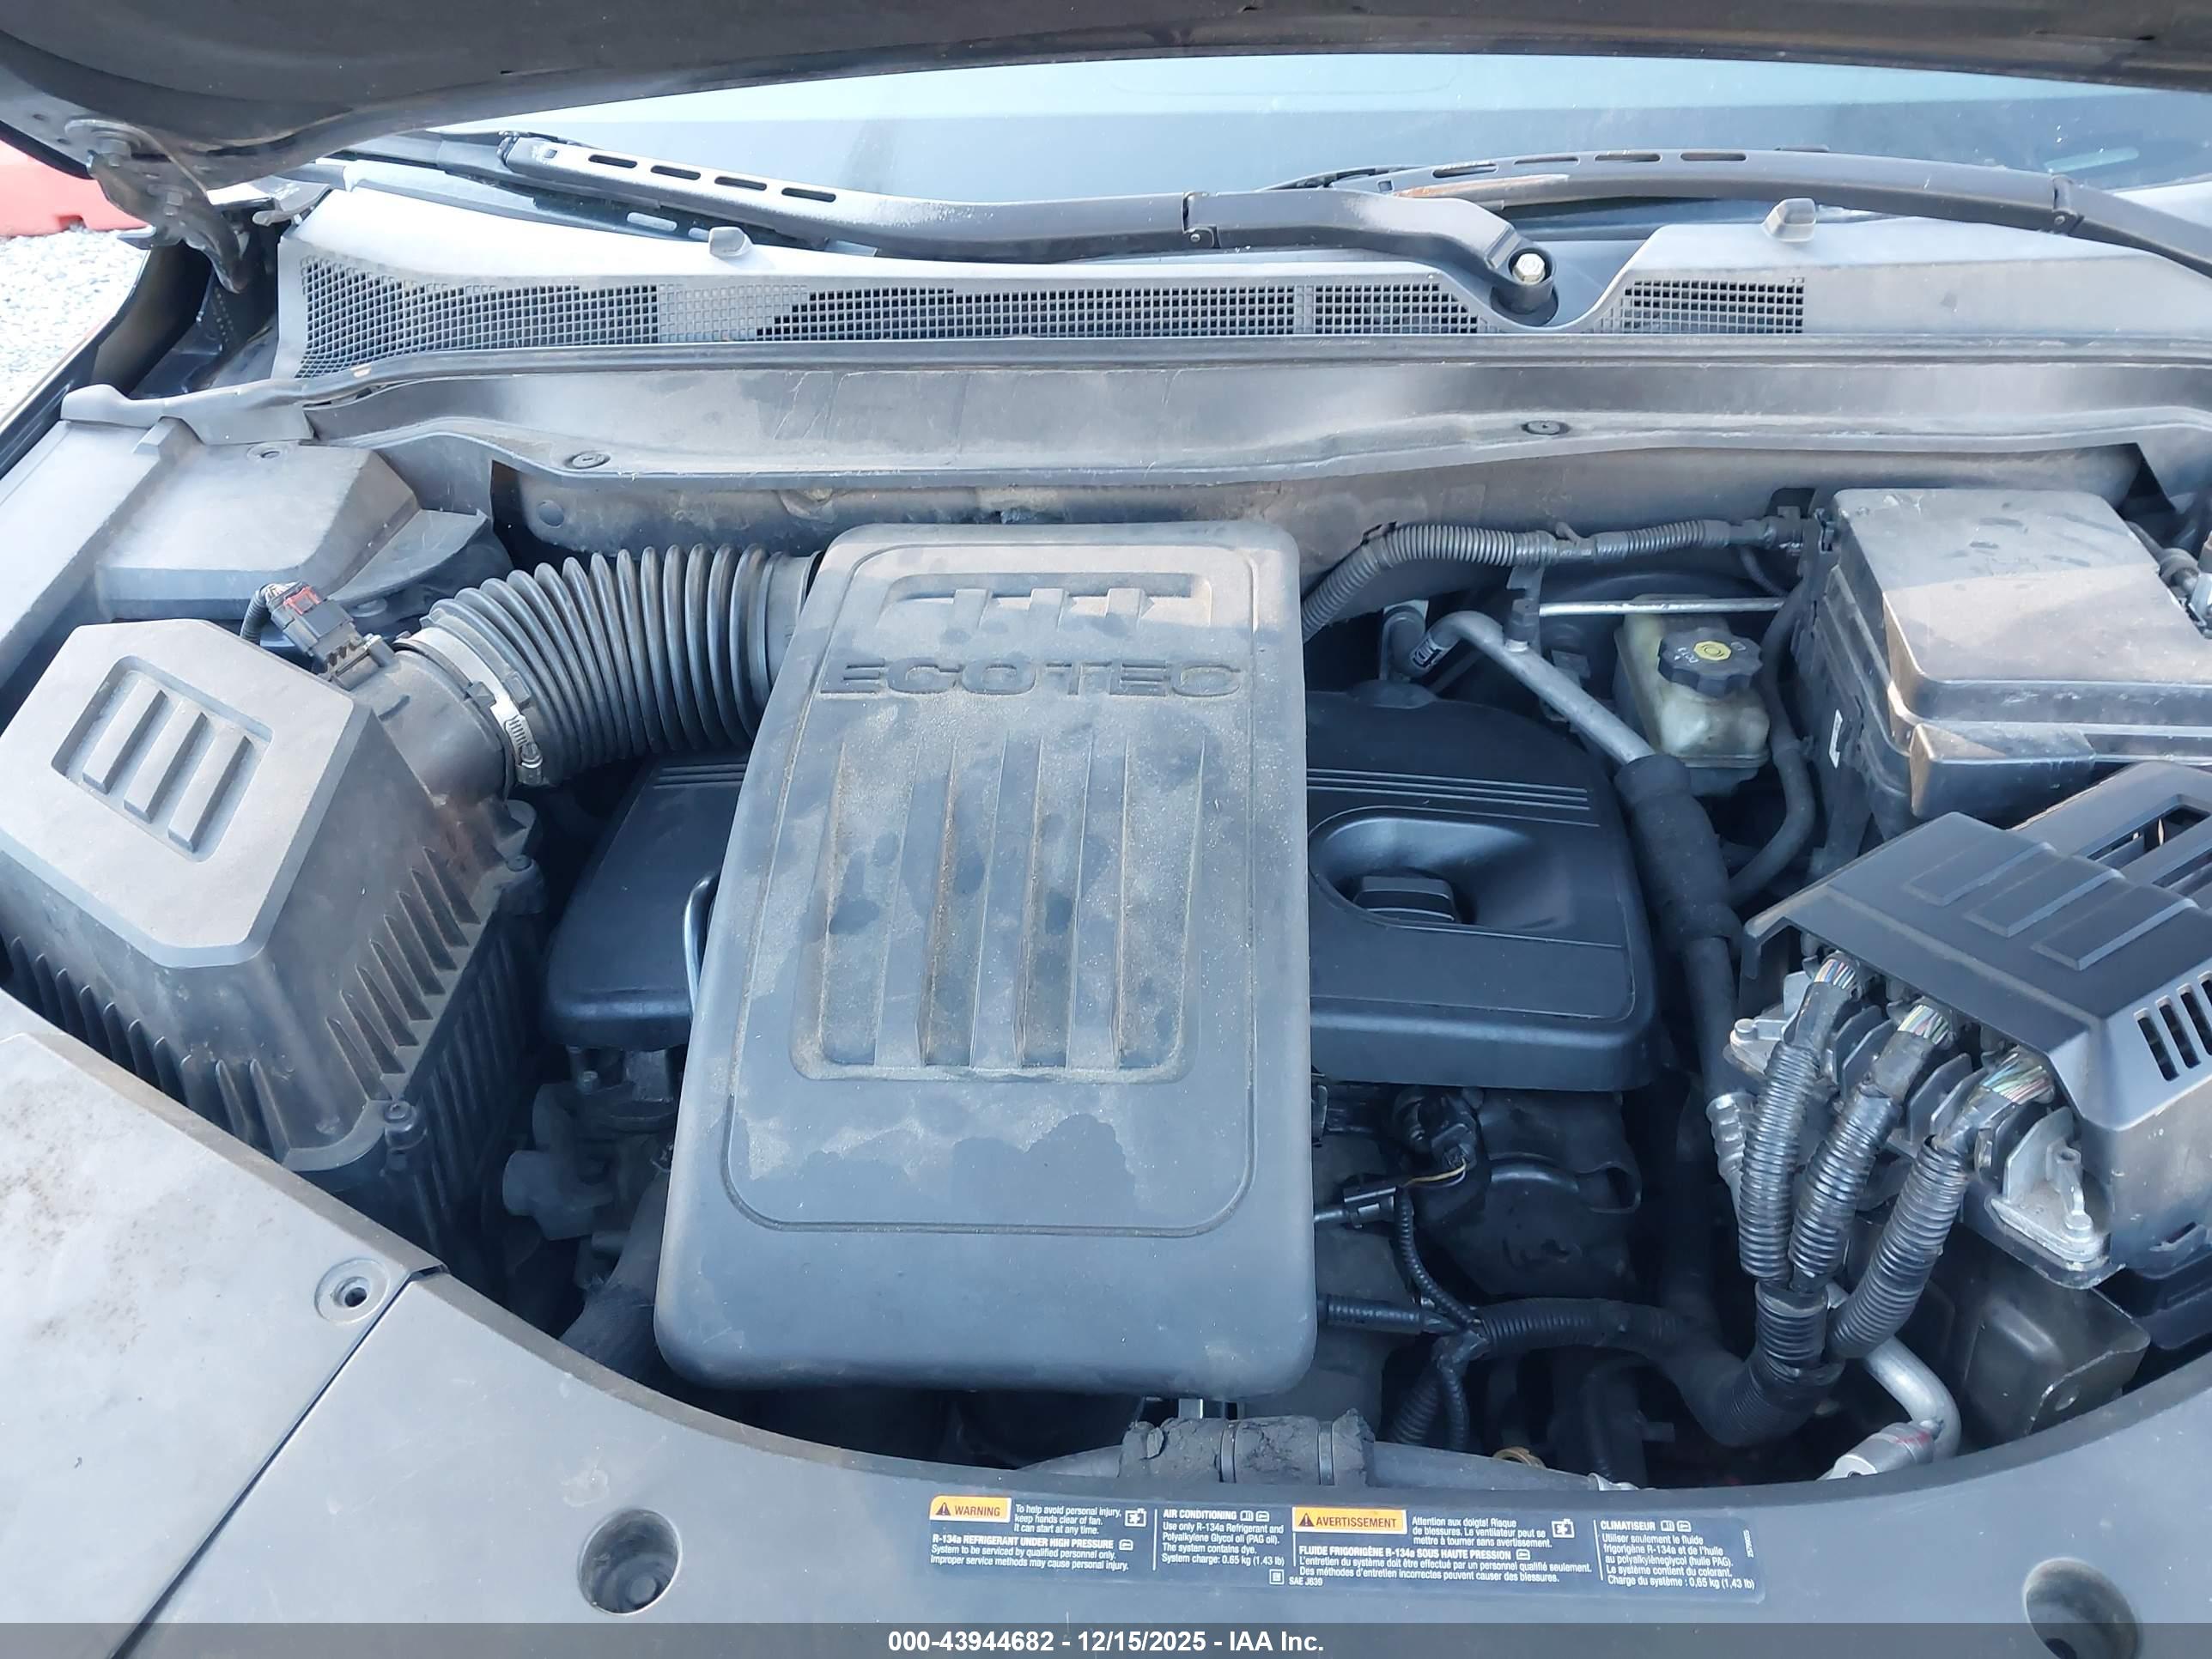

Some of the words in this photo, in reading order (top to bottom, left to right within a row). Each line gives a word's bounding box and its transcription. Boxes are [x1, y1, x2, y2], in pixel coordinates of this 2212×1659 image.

[820, 659, 1240, 696] ECOTEC
[955, 1505, 1000, 1516] WARNING
[1016, 1504, 1024, 1513] To
[1026, 1504, 1042, 1515] help
[1044, 1505, 1065, 1514] avoid
[1066, 1507, 1097, 1516] personal
[1164, 1509, 1177, 1518] AIR
[1179, 1510, 1237, 1520] CONDITIONING
[1015, 1514, 1033, 1524] keep
[1036, 1515, 1058, 1523] hands
[1079, 1516, 1087, 1524] of
[1089, 1516, 1103, 1525] fan.
[1316, 1517, 1396, 1528] AVERTISSEMENT
[1412, 1516, 1445, 1526] Attention
[1463, 1518, 1489, 1528] doigts!
[1491, 1518, 1516, 1528] Risque
[1601, 1521, 1656, 1530] CLIMATISEUR
[1036, 1524, 1054, 1533] start
[1065, 1526, 1079, 1535] any
[1080, 1525, 1099, 1534] time.
[1163, 1522, 1176, 1530] Use
[1179, 1522, 1195, 1532] only
[1197, 1522, 1224, 1532] R-134a
[1226, 1523, 1267, 1534] Refrigerant
[1269, 1525, 1284, 1534] and
[1413, 1527, 1422, 1535] de
[1476, 1528, 1516, 1537] ventilateur
[1518, 1528, 1534, 1539] peut
[933, 1534, 962, 1544] R-134a
[963, 1535, 1018, 1546] REFRIGERANT
[1020, 1537, 1048, 1547] UNDER
[1049, 1538, 1070, 1547] HIGH
[1072, 1539, 1114, 1549] PRESSURE
[1163, 1532, 1209, 1543] Polyalkylene
[1211, 1534, 1233, 1544] Glycol
[1235, 1534, 1244, 1543] oil
[1247, 1534, 1264, 1544] (PAG
[1266, 1535, 1279, 1546] oil).
[1440, 1536, 1446, 1545] à
[1447, 1537, 1474, 1546] tourner
[1497, 1538, 1553, 1547] avertissement.
[1602, 1533, 1628, 1542] Utiliser
[1631, 1534, 1671, 1544] seulement
[1673, 1535, 1680, 1544] le
[1681, 1535, 1704, 1545] fluide
[932, 1544, 958, 1554] System
[962, 1546, 969, 1554] to
[971, 1546, 980, 1554] be
[982, 1547, 1013, 1556] serviced
[1015, 1547, 1024, 1558] by
[1026, 1548, 1058, 1558] qualified
[1060, 1550, 1097, 1559] personnel
[1163, 1542, 1176, 1552] The
[1178, 1544, 1206, 1553] system
[1207, 1545, 1238, 1553] contains
[1299, 1546, 1328, 1555] FLUIDE
[1386, 1547, 1415, 1558] R-134a
[1417, 1548, 1439, 1558] SOUS
[1441, 1549, 1468, 1559] HAUTE
[1470, 1549, 1511, 1559] PRESSION
[1647, 1544, 1676, 1554] R-134a
[1678, 1546, 1686, 1554] et
[1687, 1546, 1698, 1555] de
[931, 1555, 964, 1565] Improper
[966, 1557, 993, 1565] service
[995, 1558, 1027, 1566] methods
[1030, 1559, 1046, 1568] may
[1072, 1560, 1104, 1570] personal
[1106, 1560, 1128, 1571] injury.
[1162, 1553, 1189, 1564] System
[1192, 1554, 1220, 1565] charge:
[1222, 1555, 1239, 1565] 0.65
[1242, 1556, 1251, 1566] kg
[1253, 1556, 1273, 1566] (1.43
[1274, 1557, 1285, 1566] lb)
[1689, 1556, 1711, 1566] (huile
[1712, 1557, 1733, 1568] PAG).
[1606, 1565, 1616, 1574] Le
[1618, 1565, 1650, 1576] système
[1653, 1566, 1684, 1576] contient
[1686, 1566, 1697, 1576] du
[1698, 1567, 1733, 1577] colorant.
[1289, 1577, 1304, 1585] SAE
[1305, 1577, 1322, 1586] J639
[1607, 1575, 1636, 1587] Charge
[1638, 1576, 1649, 1585] du
[1650, 1577, 1682, 1587] système
[1689, 1577, 1707, 1588] 0,65
[1709, 1577, 1720, 1589] kg
[1722, 1578, 1742, 1589] (1,43
[1743, 1578, 1755, 1590] lb)
